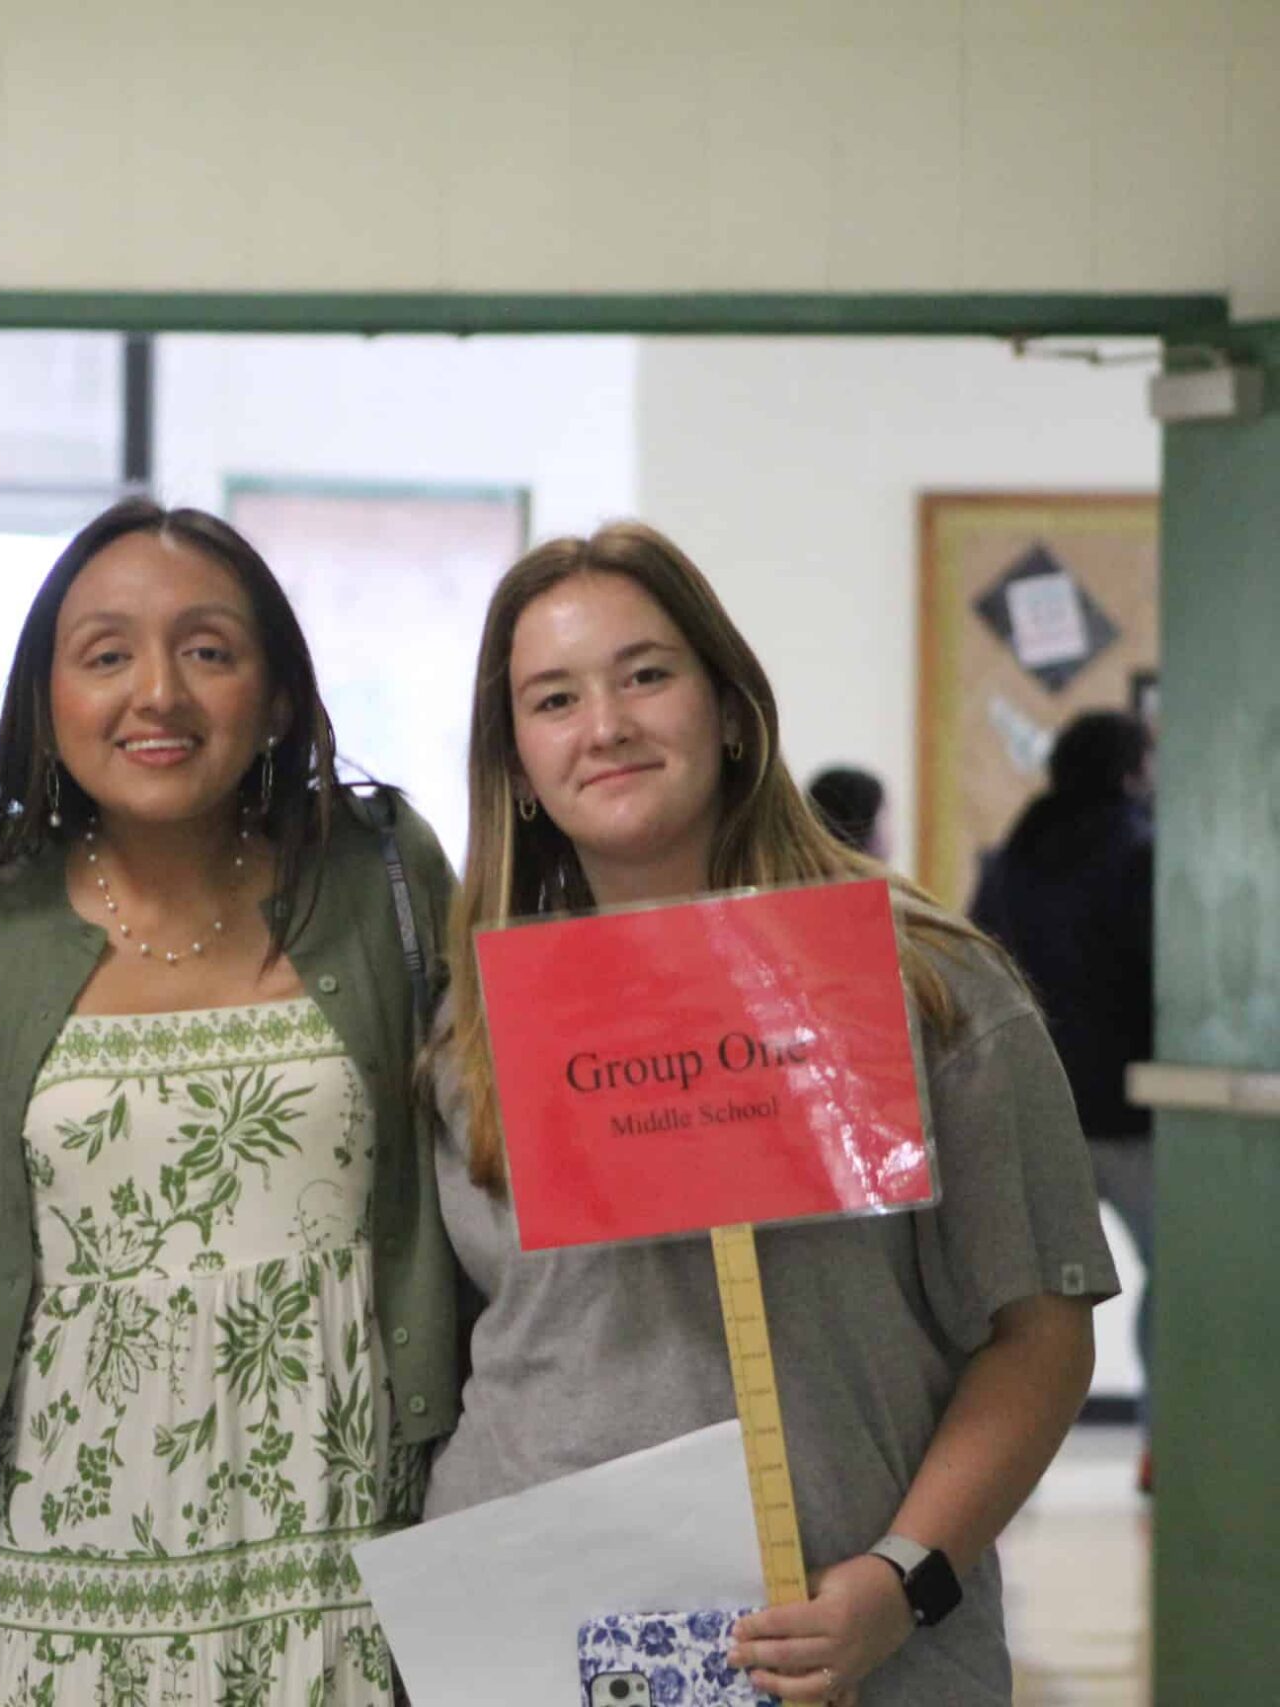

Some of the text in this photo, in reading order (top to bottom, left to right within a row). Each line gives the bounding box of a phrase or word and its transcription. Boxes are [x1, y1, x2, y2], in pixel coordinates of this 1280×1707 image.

[566, 1032, 808, 1092] Group One
[611, 1096, 779, 1138] Middle School
